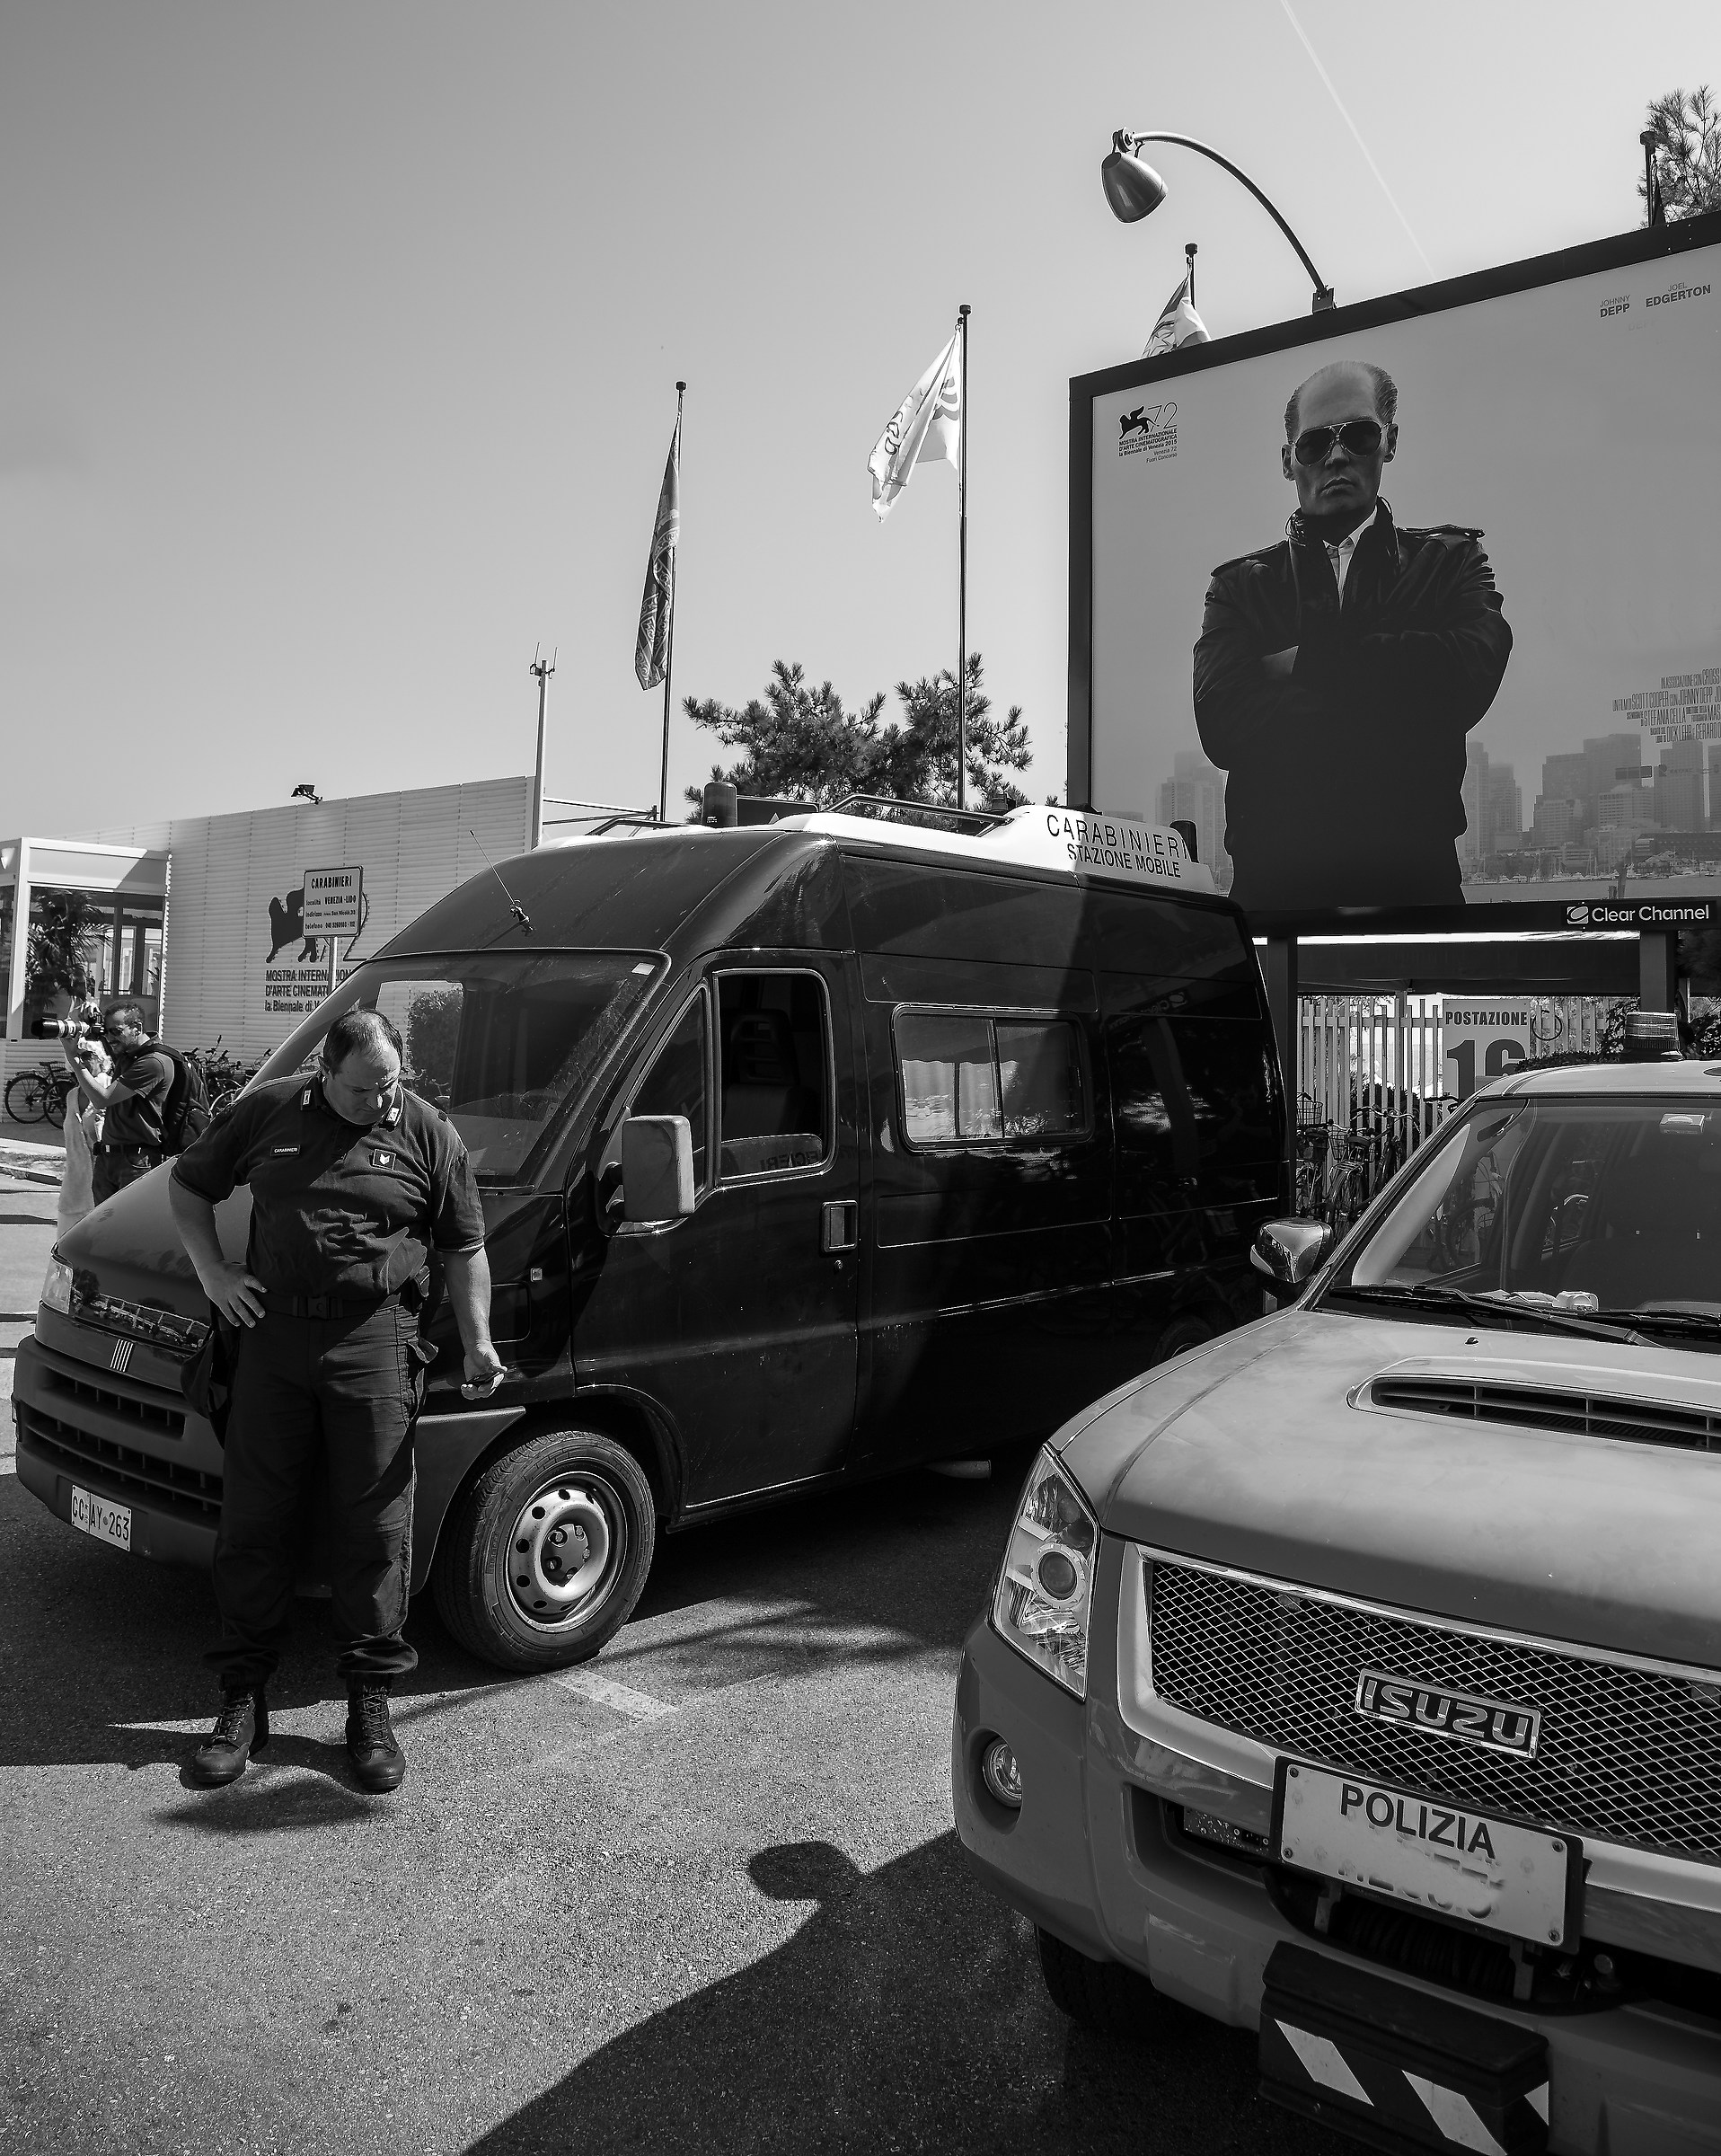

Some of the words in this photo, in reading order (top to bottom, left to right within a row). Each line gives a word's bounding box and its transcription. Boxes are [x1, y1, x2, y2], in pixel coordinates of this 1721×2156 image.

[1668, 282, 1687, 292] JOEL
[1600, 295, 1630, 307] JOHNNY
[1646, 284, 1711, 308] EDGERTON
[1600, 303, 1630, 318] DEPP
[1148, 402, 1178, 432] 72
[1118, 437, 1138, 446] MOSTRA
[1138, 429, 1178, 442] INTERNAZIONALE
[1118, 444, 1134, 452] D'ARTE
[1134, 434, 1178, 448] CINEMATOGRAFICA
[1124, 448, 1143, 456] Biennale
[1632, 693, 1649, 710] SCOTT
[1649, 690, 1669, 709] COOPER
[1678, 687, 1699, 706] JOHNNY
[1699, 686, 1713, 704] DEPP
[1670, 707, 1686, 725] CELLA
[1046, 814, 1187, 860] CARABINIERI
[1067, 843, 1134, 870] STAZIONE
[1134, 854, 1182, 879] MOBILE
[311, 875, 352, 889] CARABINIERI
[324, 896, 343, 905] VENEZIA
[1591, 907, 1636, 923] Clear
[1638, 904, 1710, 922] Channel
[265, 969, 296, 982] MOSTRA
[265, 985, 292, 997] D'ARTE
[273, 999, 304, 1012] Biennale
[1445, 1011, 1528, 1026] POSTAZIONE
[108, 1511, 130, 1542] 263
[1364, 1679, 1529, 1746] ISUZU
[1340, 1782, 1496, 1860] POLIZIA
